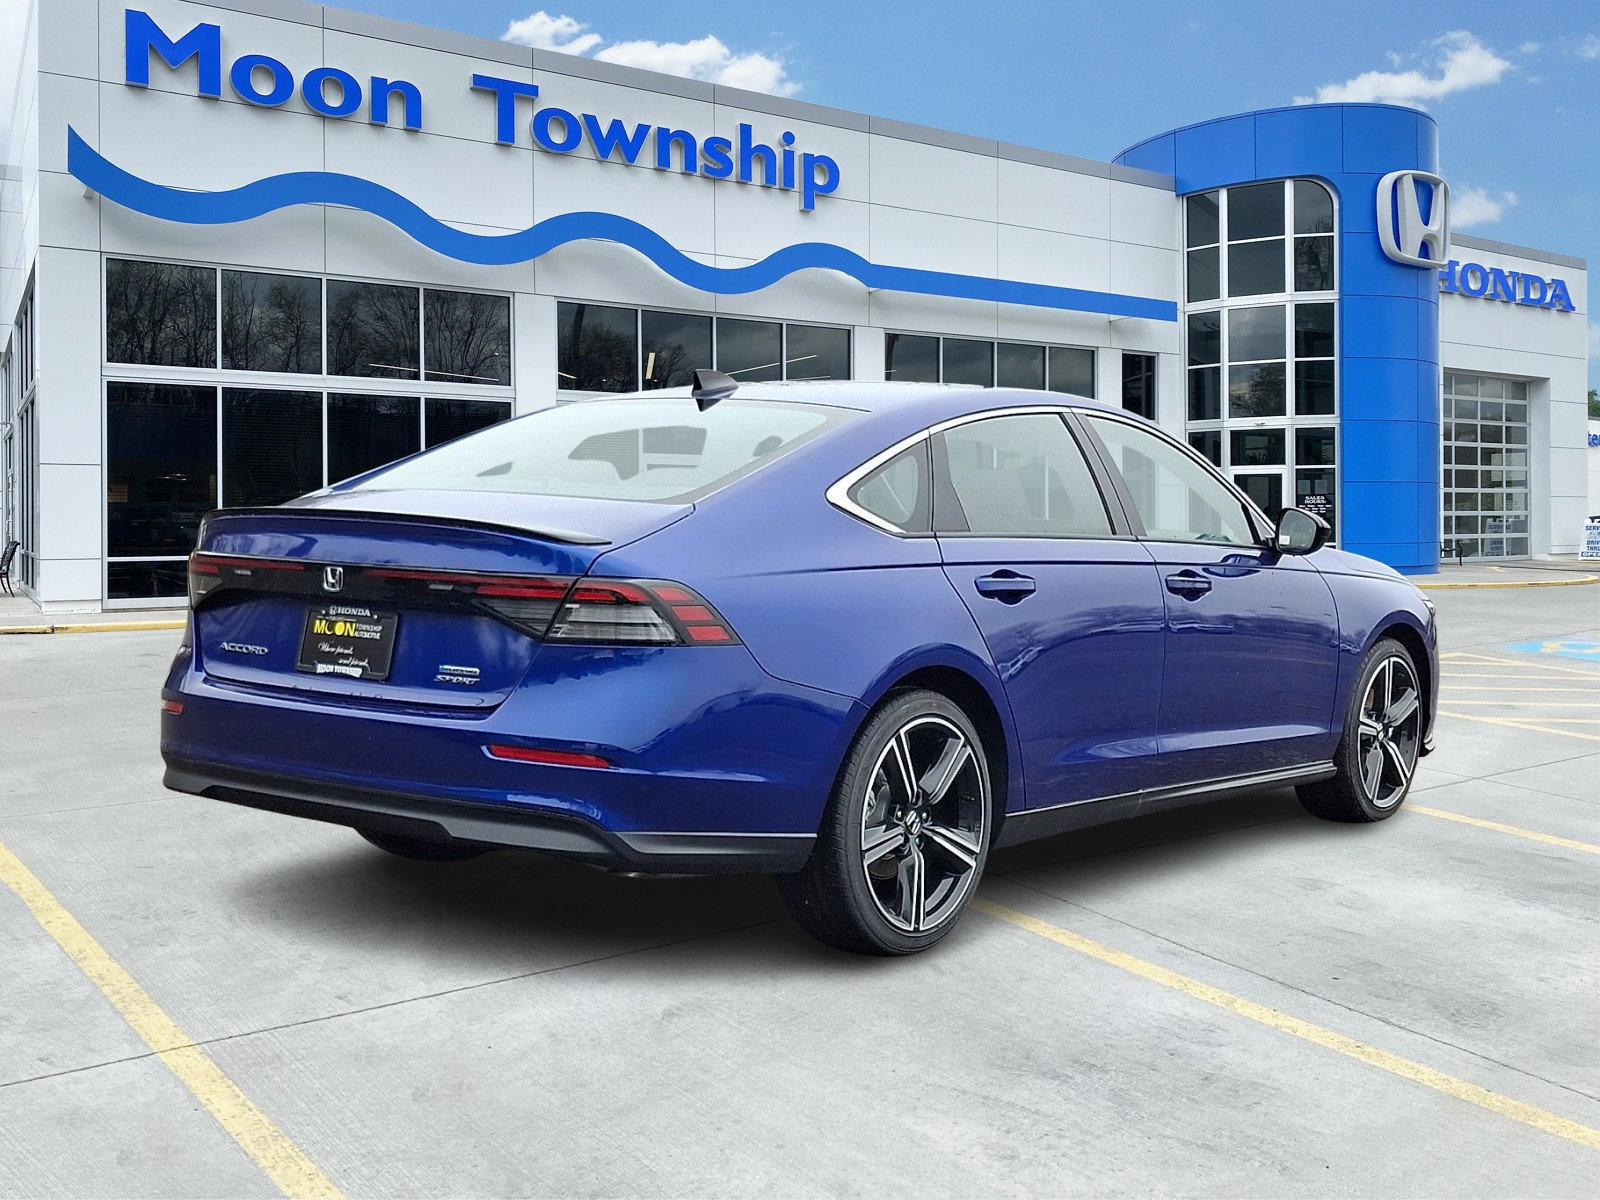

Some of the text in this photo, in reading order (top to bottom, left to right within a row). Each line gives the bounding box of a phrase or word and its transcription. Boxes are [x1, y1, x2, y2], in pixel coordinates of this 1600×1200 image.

[125, 8, 841, 213] Moon Township
[337, 606, 371, 617] HONDA
[313, 619, 356, 637] MOON
[220, 642, 269, 655] ACCORD
[433, 674, 481, 685] SPORT
